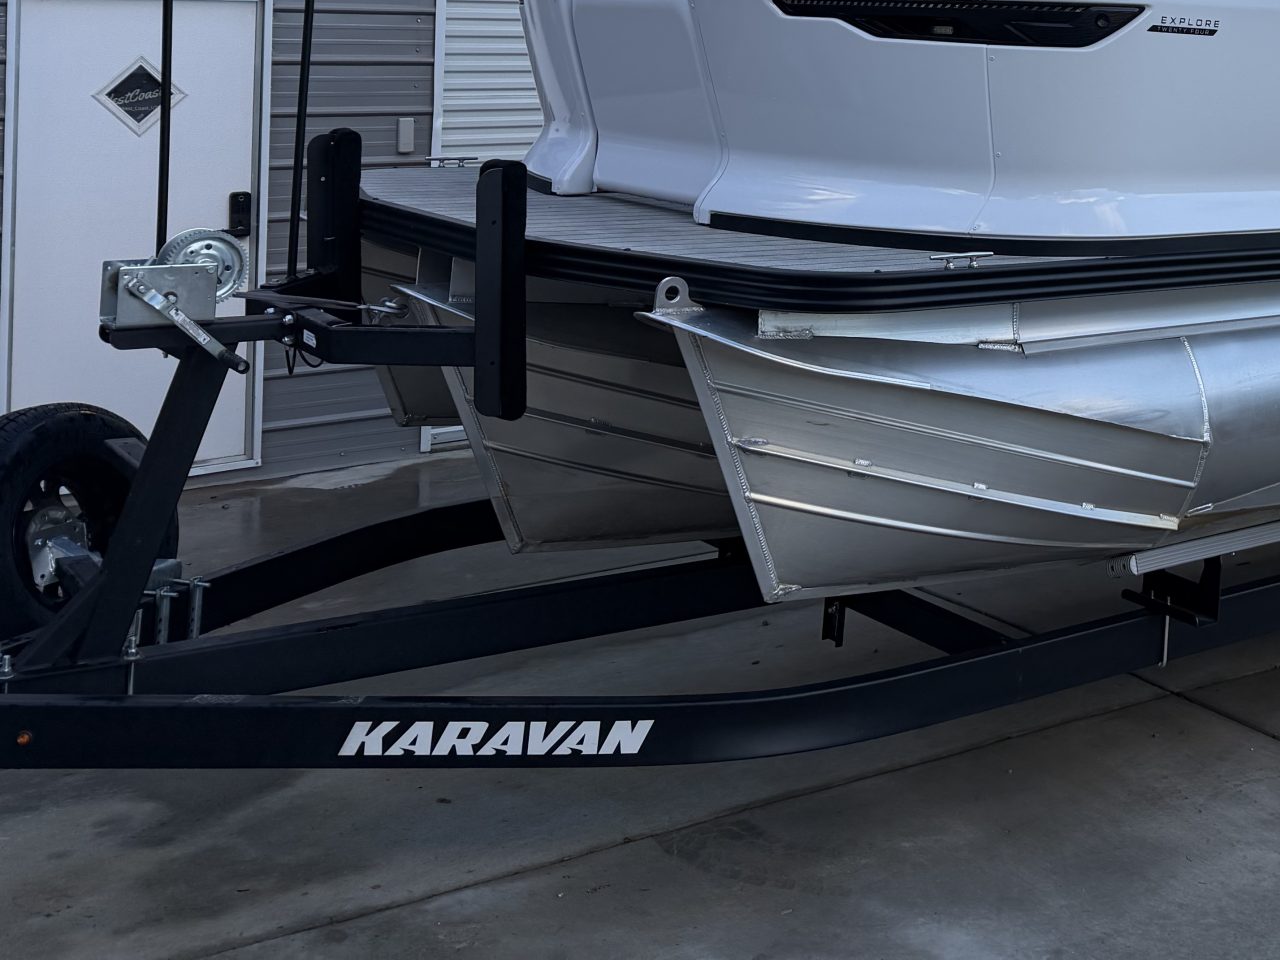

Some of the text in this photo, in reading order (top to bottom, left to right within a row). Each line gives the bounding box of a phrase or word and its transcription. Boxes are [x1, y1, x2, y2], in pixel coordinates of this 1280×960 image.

[1160, 16, 1220, 28] EXPLORE
[1157, 26, 1188, 34] TWENTY
[337, 719, 655, 756] KARAVAN
